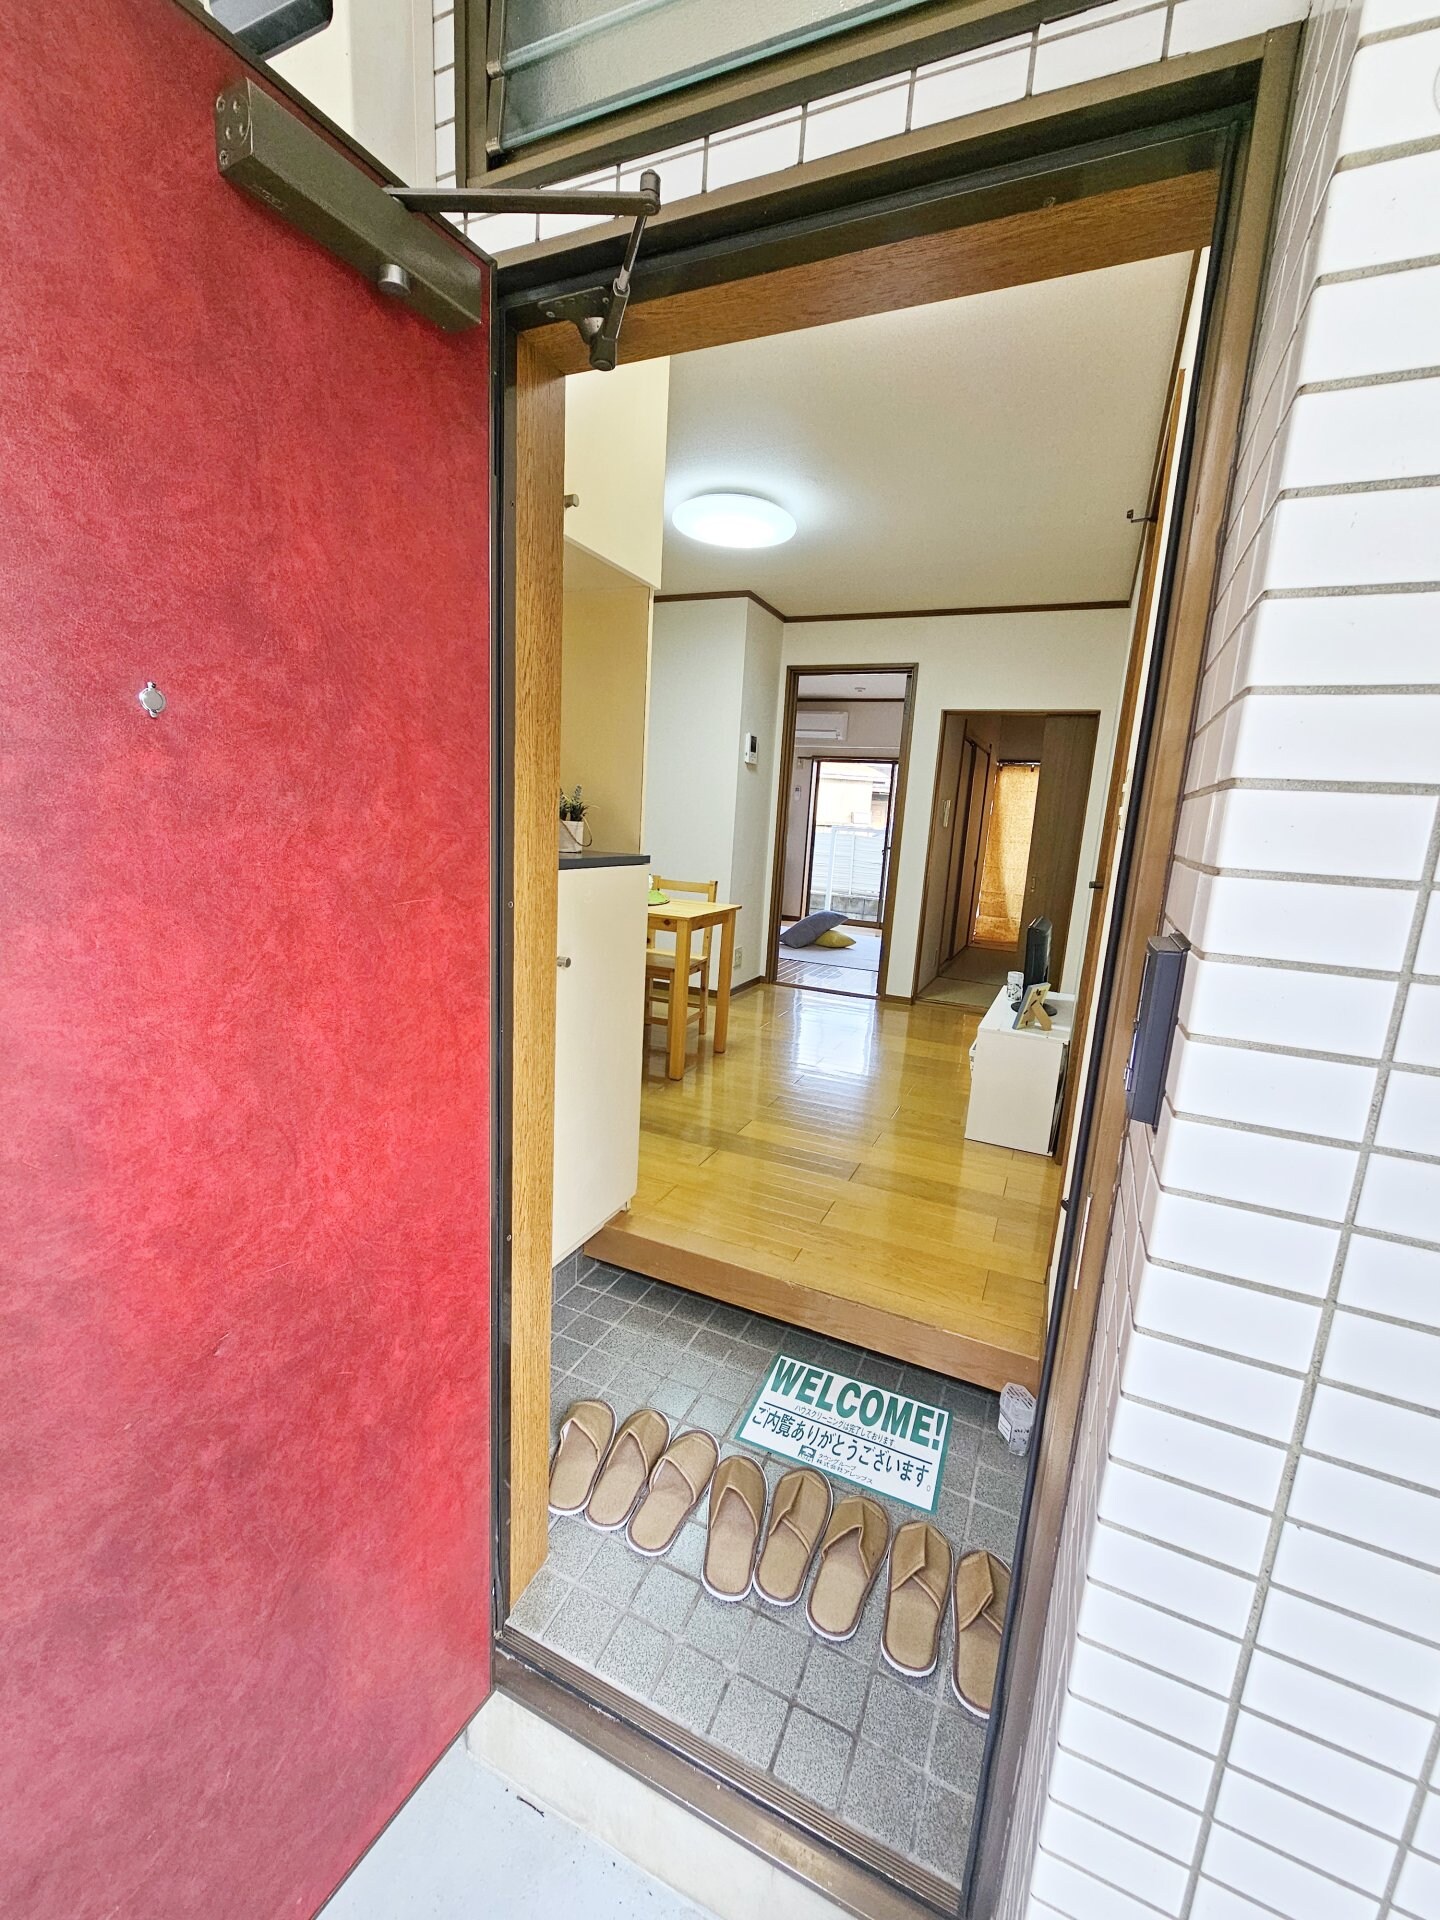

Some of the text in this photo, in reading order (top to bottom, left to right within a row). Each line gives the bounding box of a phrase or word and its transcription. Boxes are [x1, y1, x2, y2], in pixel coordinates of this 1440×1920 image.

[770, 1358, 946, 1451] WELCOME!
[794, 1404, 896, 1447] ハウスクリーニングは完了しております
